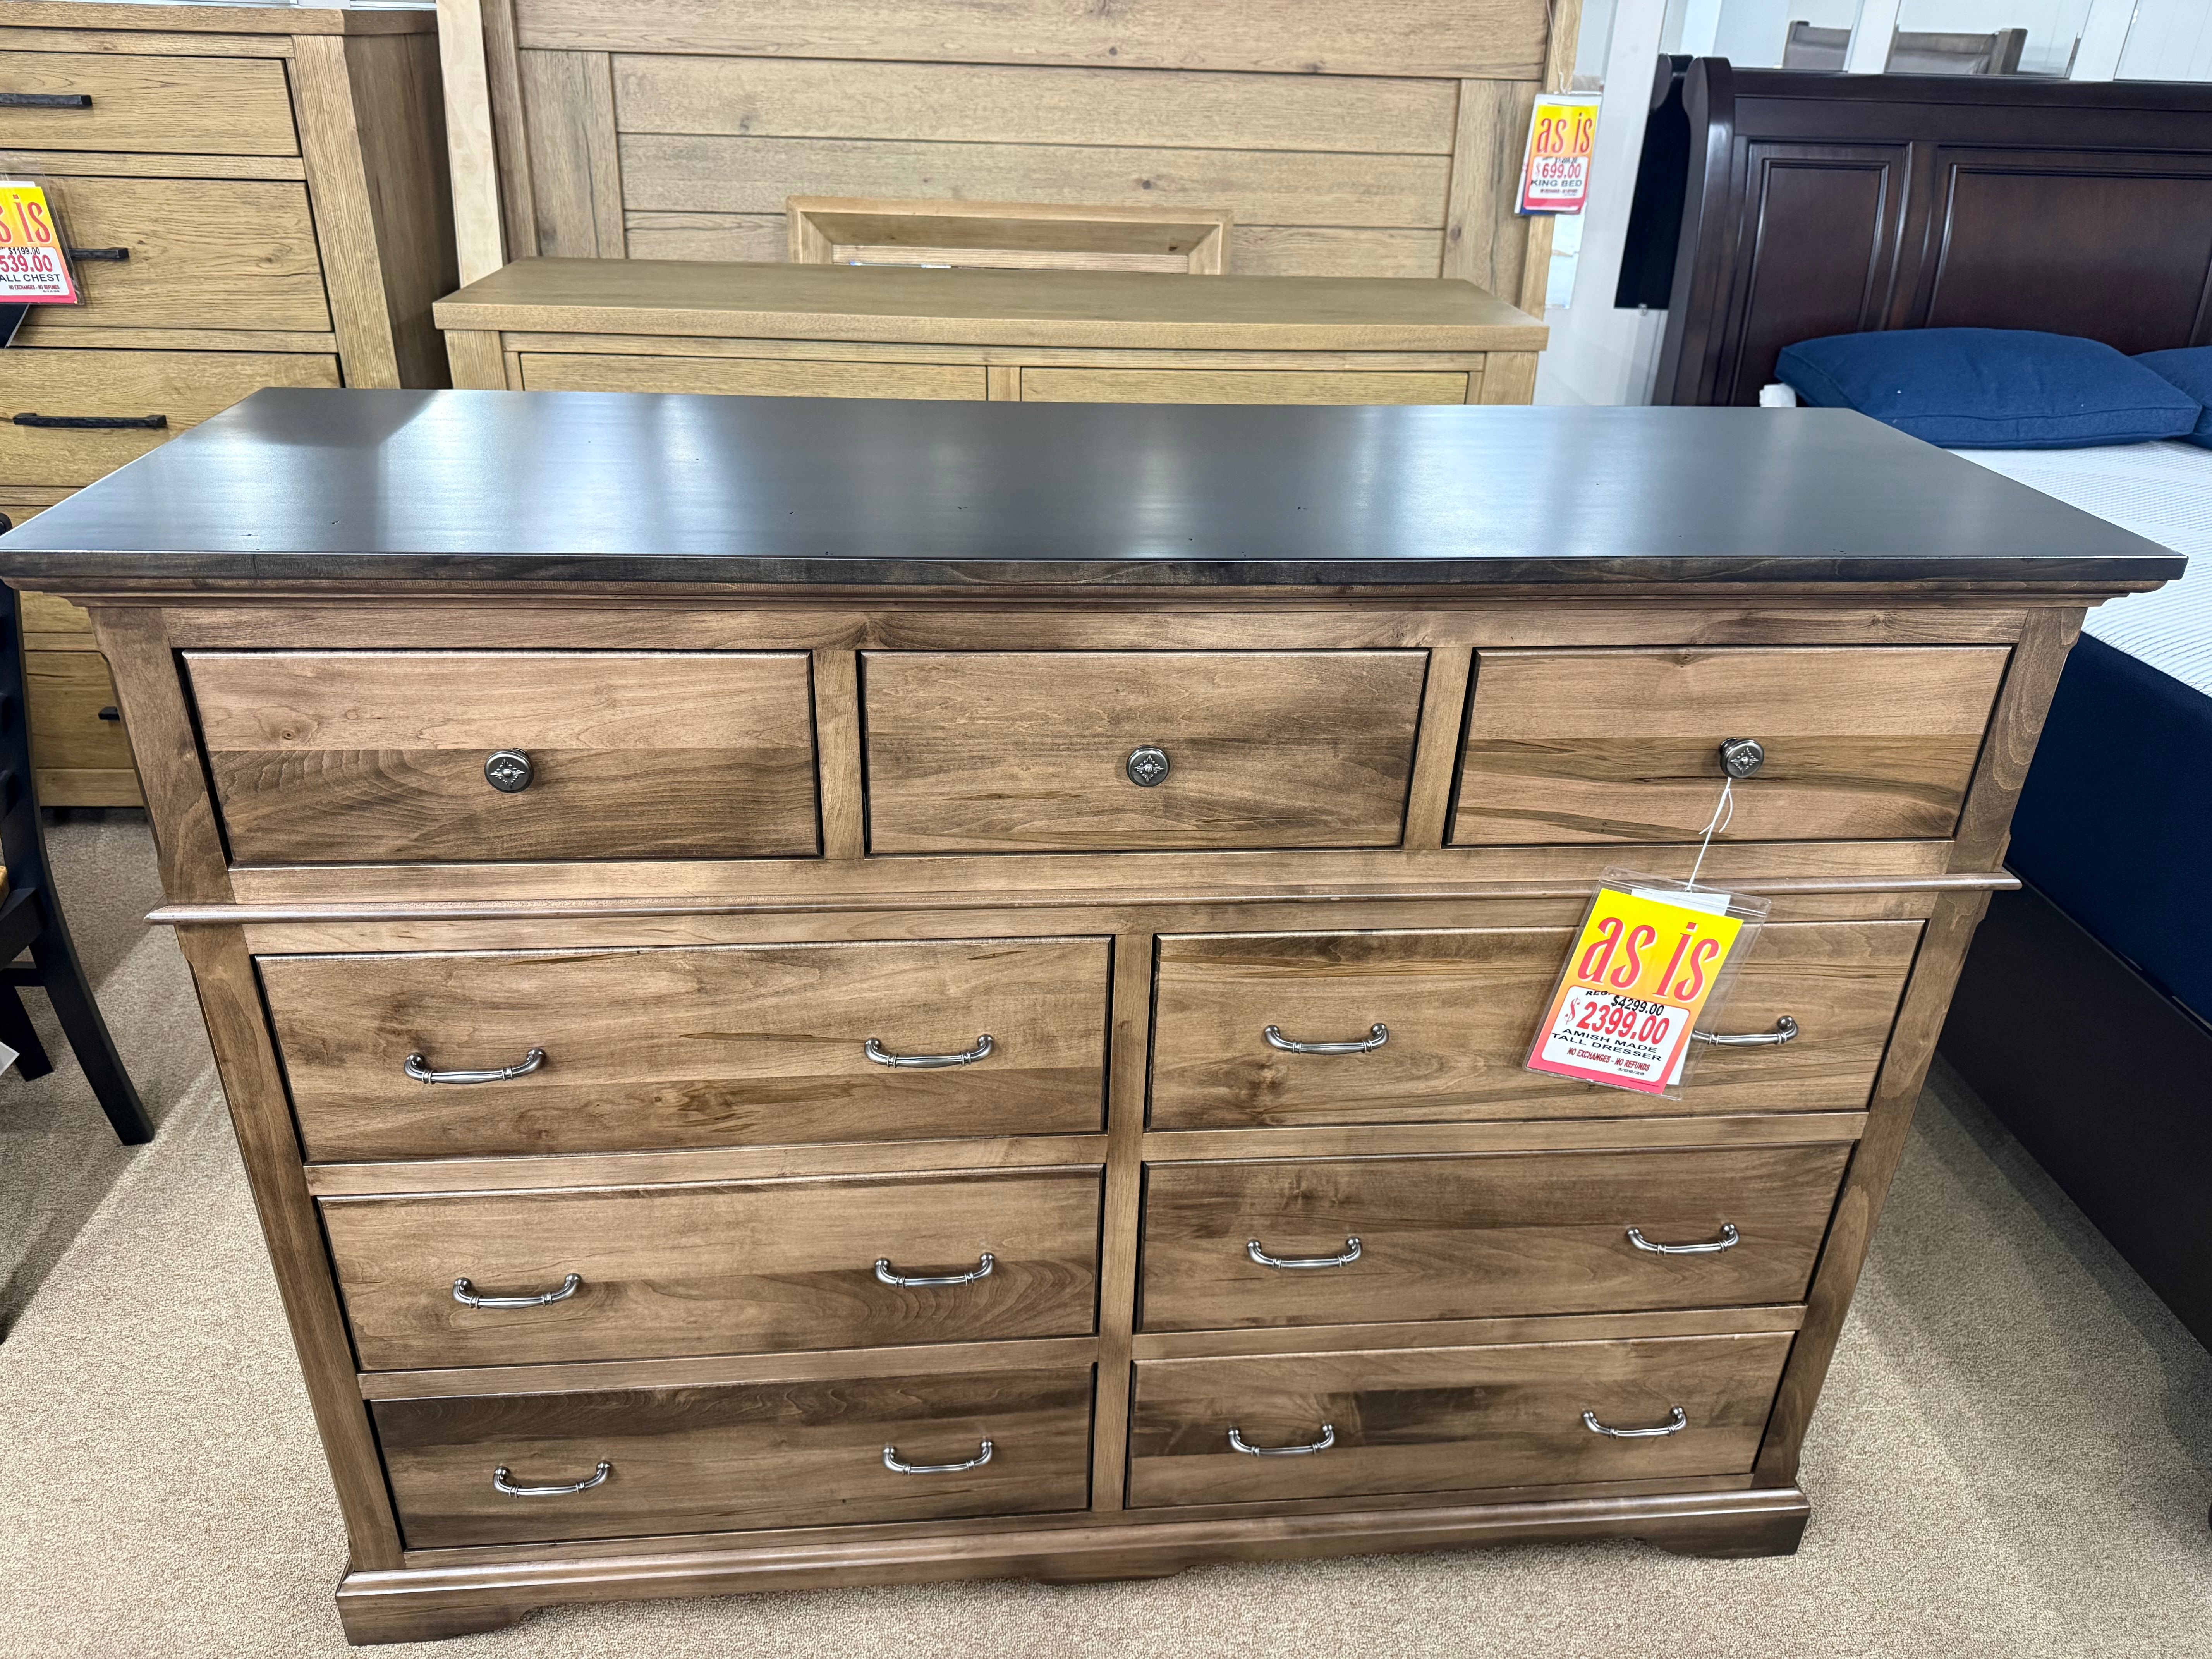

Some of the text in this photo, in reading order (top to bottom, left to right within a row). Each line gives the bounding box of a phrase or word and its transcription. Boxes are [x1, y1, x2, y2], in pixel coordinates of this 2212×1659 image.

[1537, 112, 1592, 153] as is
[13, 194, 51, 243] is
[23, 274, 60, 282] CHEST
[1578, 917, 1719, 1001] as is
[1611, 995, 1664, 1016] $4299.00
[1551, 1032, 1662, 1061] TALL DRESSER
[1561, 1029, 1658, 1053] AMISH MADE
[1567, 1047, 1576, 1056] NO
[1576, 1049, 1611, 1063] EXCHANGES
[1614, 1057, 1624, 1066] NO
[1624, 1060, 1651, 1072] REFUNDS
